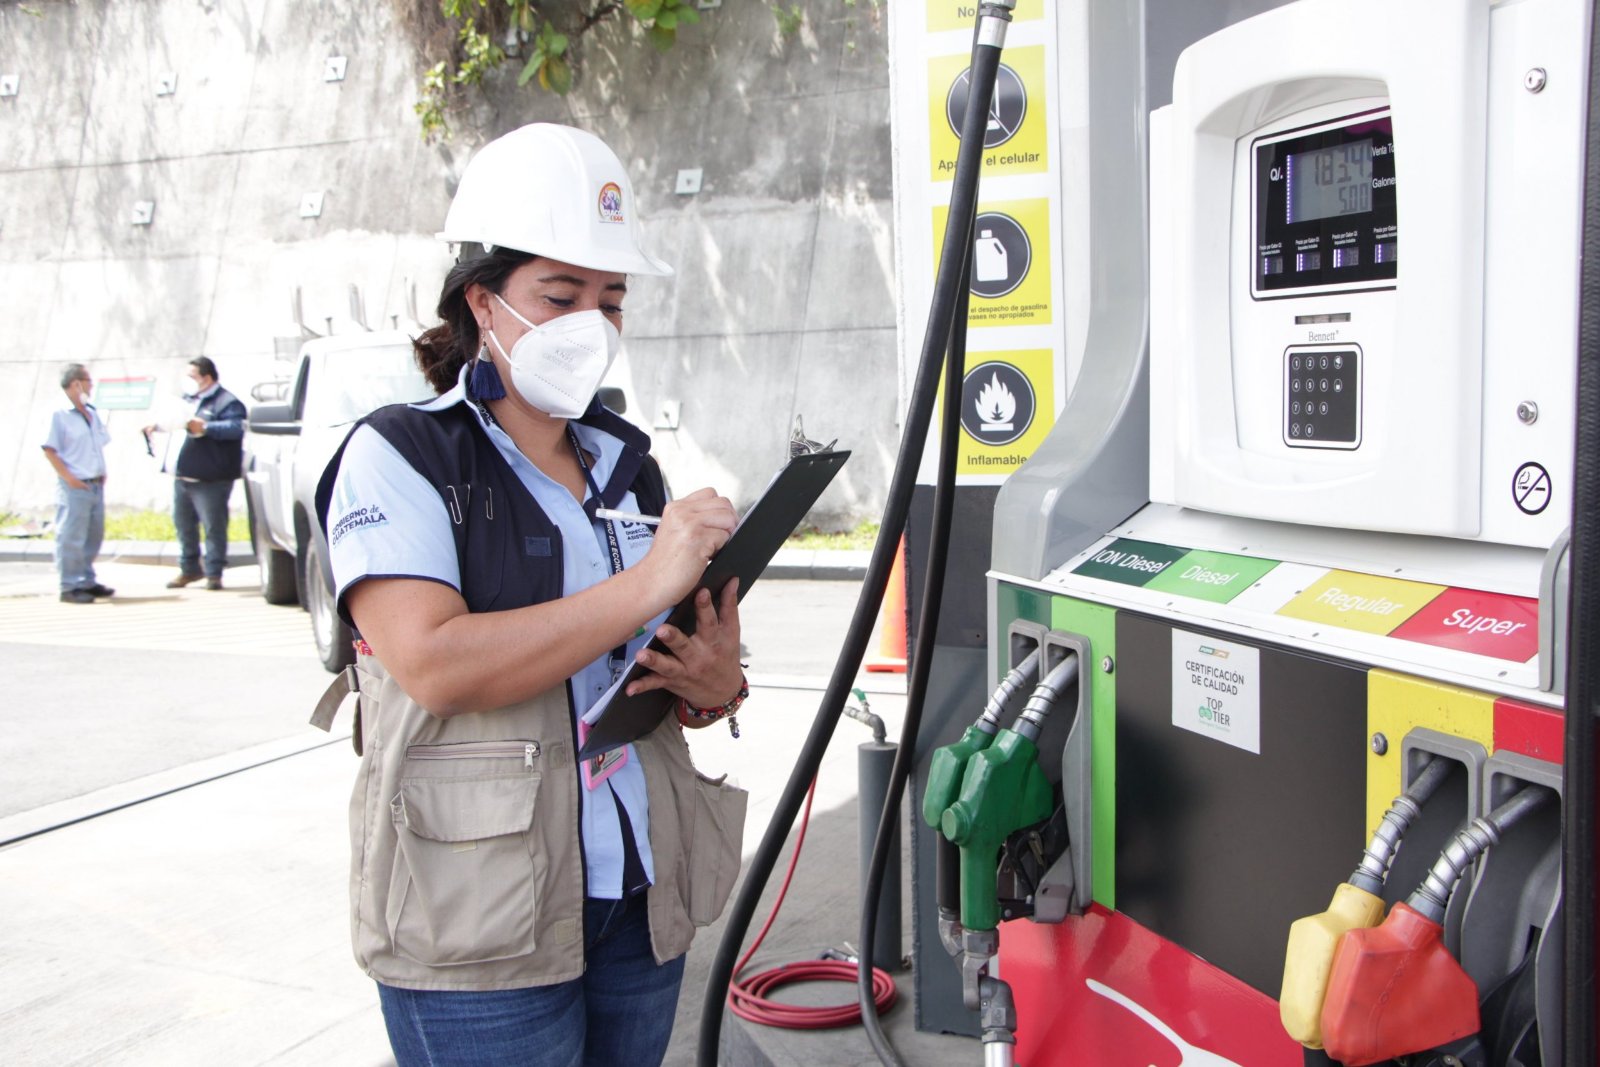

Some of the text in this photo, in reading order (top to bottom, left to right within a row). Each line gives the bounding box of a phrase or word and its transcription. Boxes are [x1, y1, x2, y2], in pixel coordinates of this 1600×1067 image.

[957, 6, 975, 18] No
[986, 152, 996, 166] el
[1000, 151, 1040, 166] celular
[978, 305, 1009, 314] despacho
[1020, 303, 1048, 312] gasolina
[998, 311, 1034, 319] apropiados
[967, 454, 1027, 466] Inflamable
[332, 507, 368, 535] GOBIERNO
[369, 504, 380, 514] de
[332, 512, 387, 546] GUATEMALA
[608, 535, 617, 546] DE
[1091, 549, 1172, 574] ION Diesel
[1179, 565, 1240, 586] Diesel
[1315, 587, 1404, 616] Regular
[1443, 608, 1527, 636] Super
[1185, 660, 1245, 685] CERTIFICACIÓN
[1191, 674, 1238, 696] DE CALIDAD
[1206, 696, 1223, 711] TOP
[1213, 710, 1231, 727] TIER
